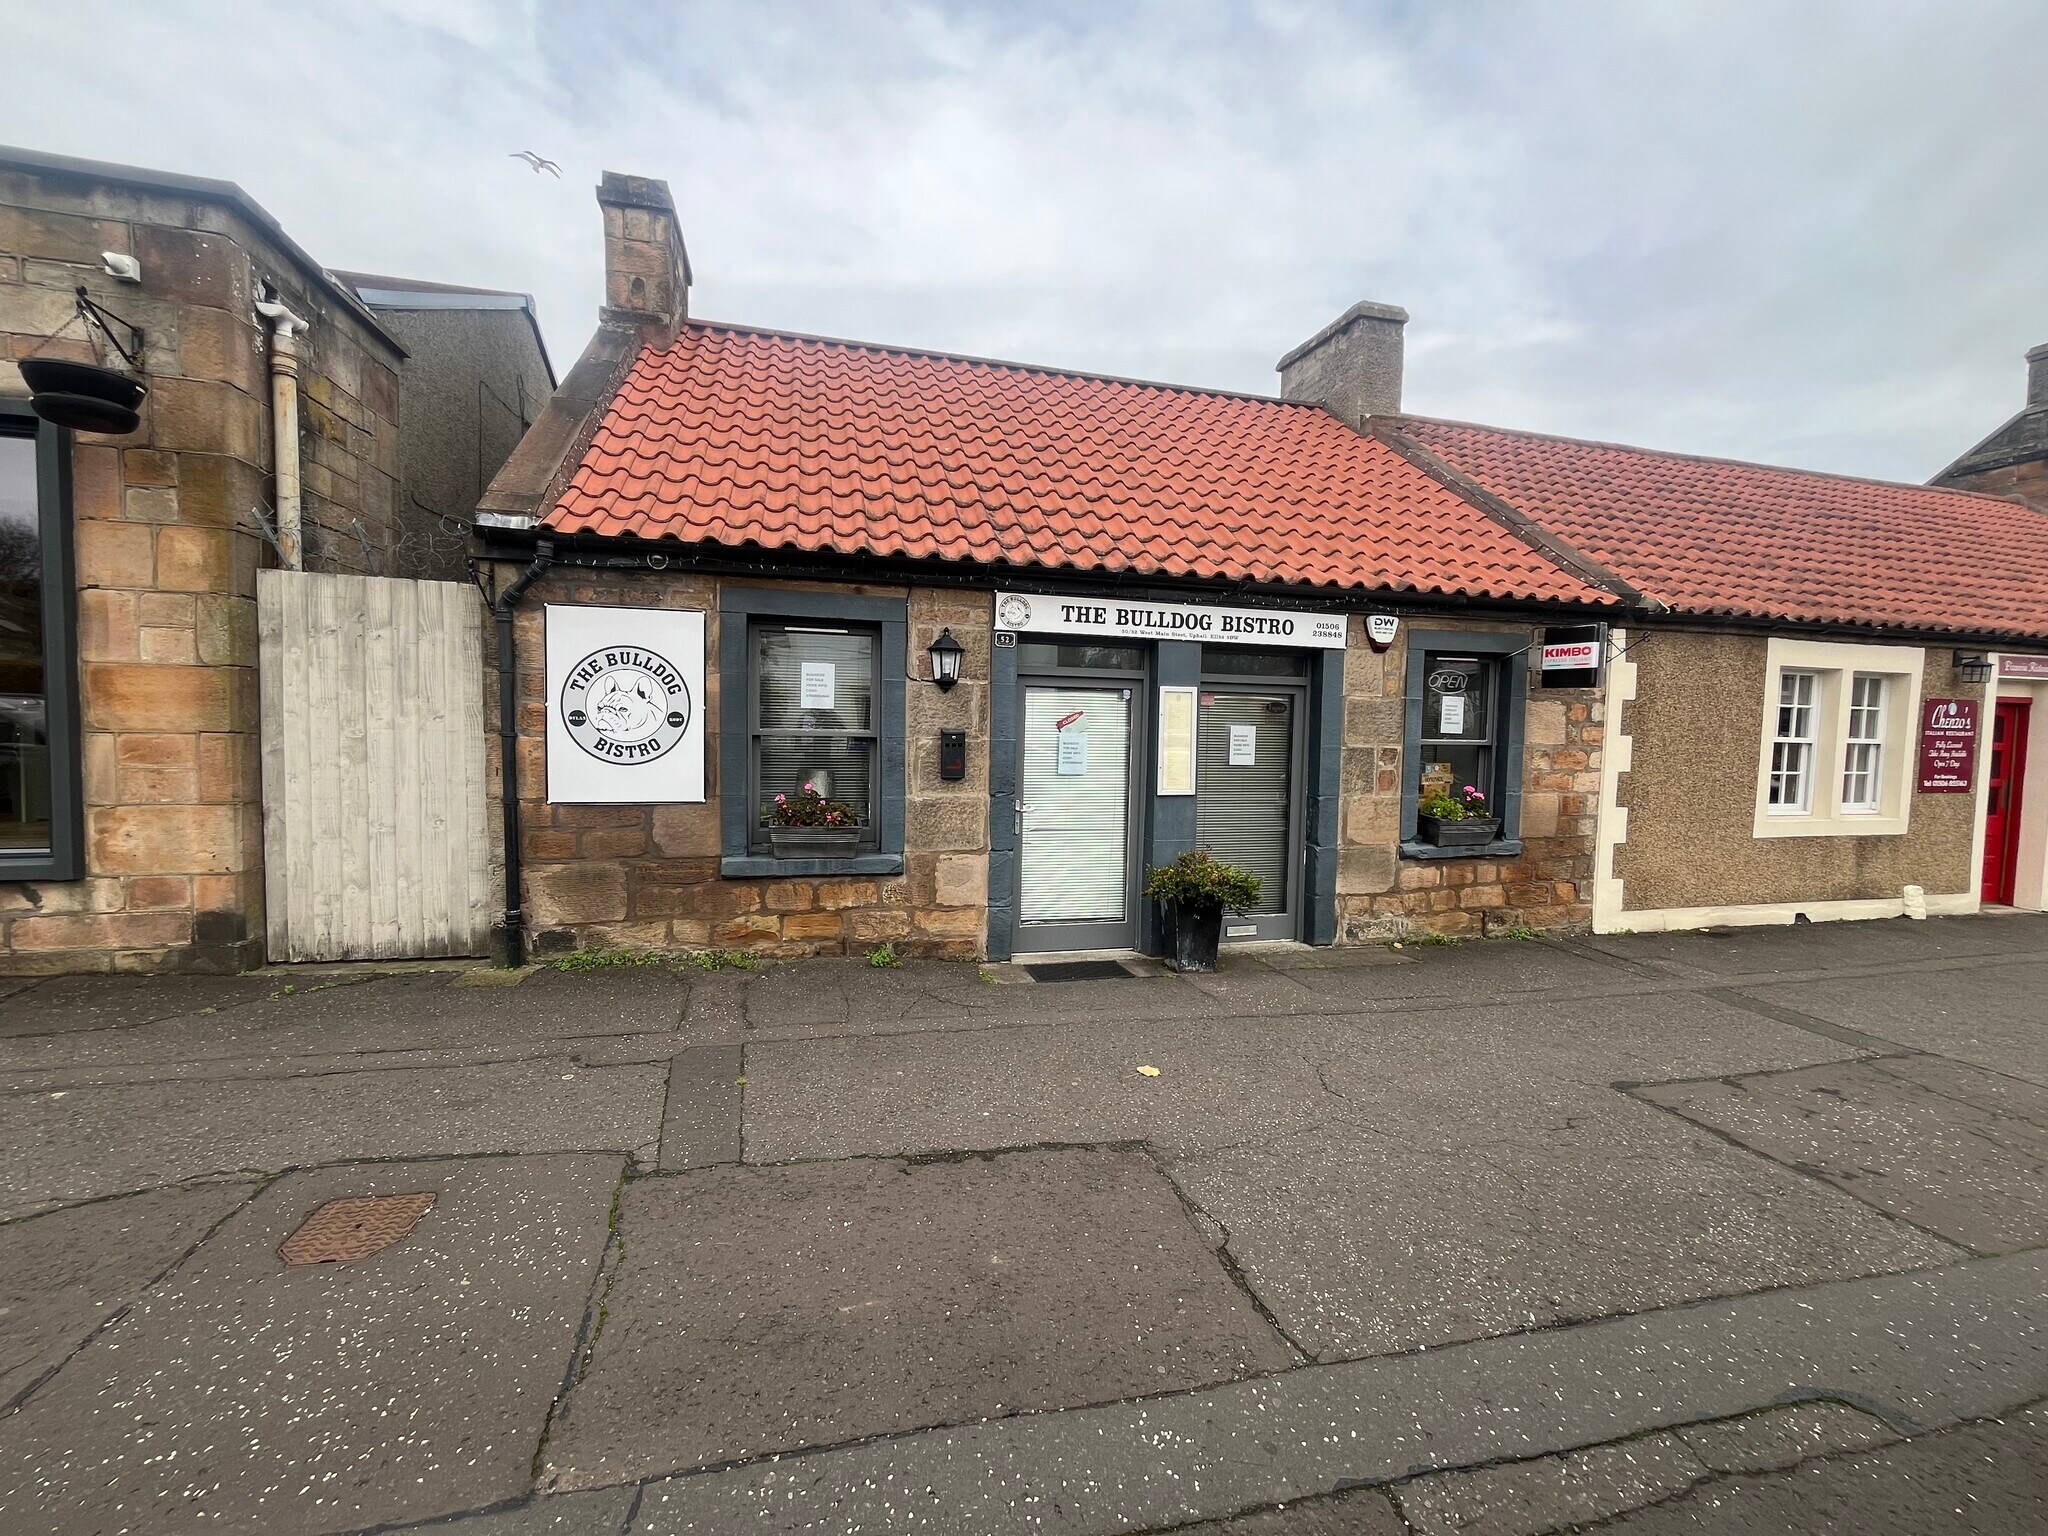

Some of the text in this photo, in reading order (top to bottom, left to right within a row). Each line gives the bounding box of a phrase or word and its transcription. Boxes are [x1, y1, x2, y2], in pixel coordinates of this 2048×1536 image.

[1061, 605, 1294, 636] THE BULLDOG BISTRO
[1316, 622, 1340, 630] 01506
[1374, 618, 1394, 626] DW
[1312, 630, 1343, 639] 238848
[1544, 646, 1592, 658] KIMBO
[570, 652, 682, 696] THE BULLDOG
[1428, 674, 1468, 689] OPEN
[1062, 713, 1080, 725] CLOSED
[593, 737, 662, 759] BISTRO
